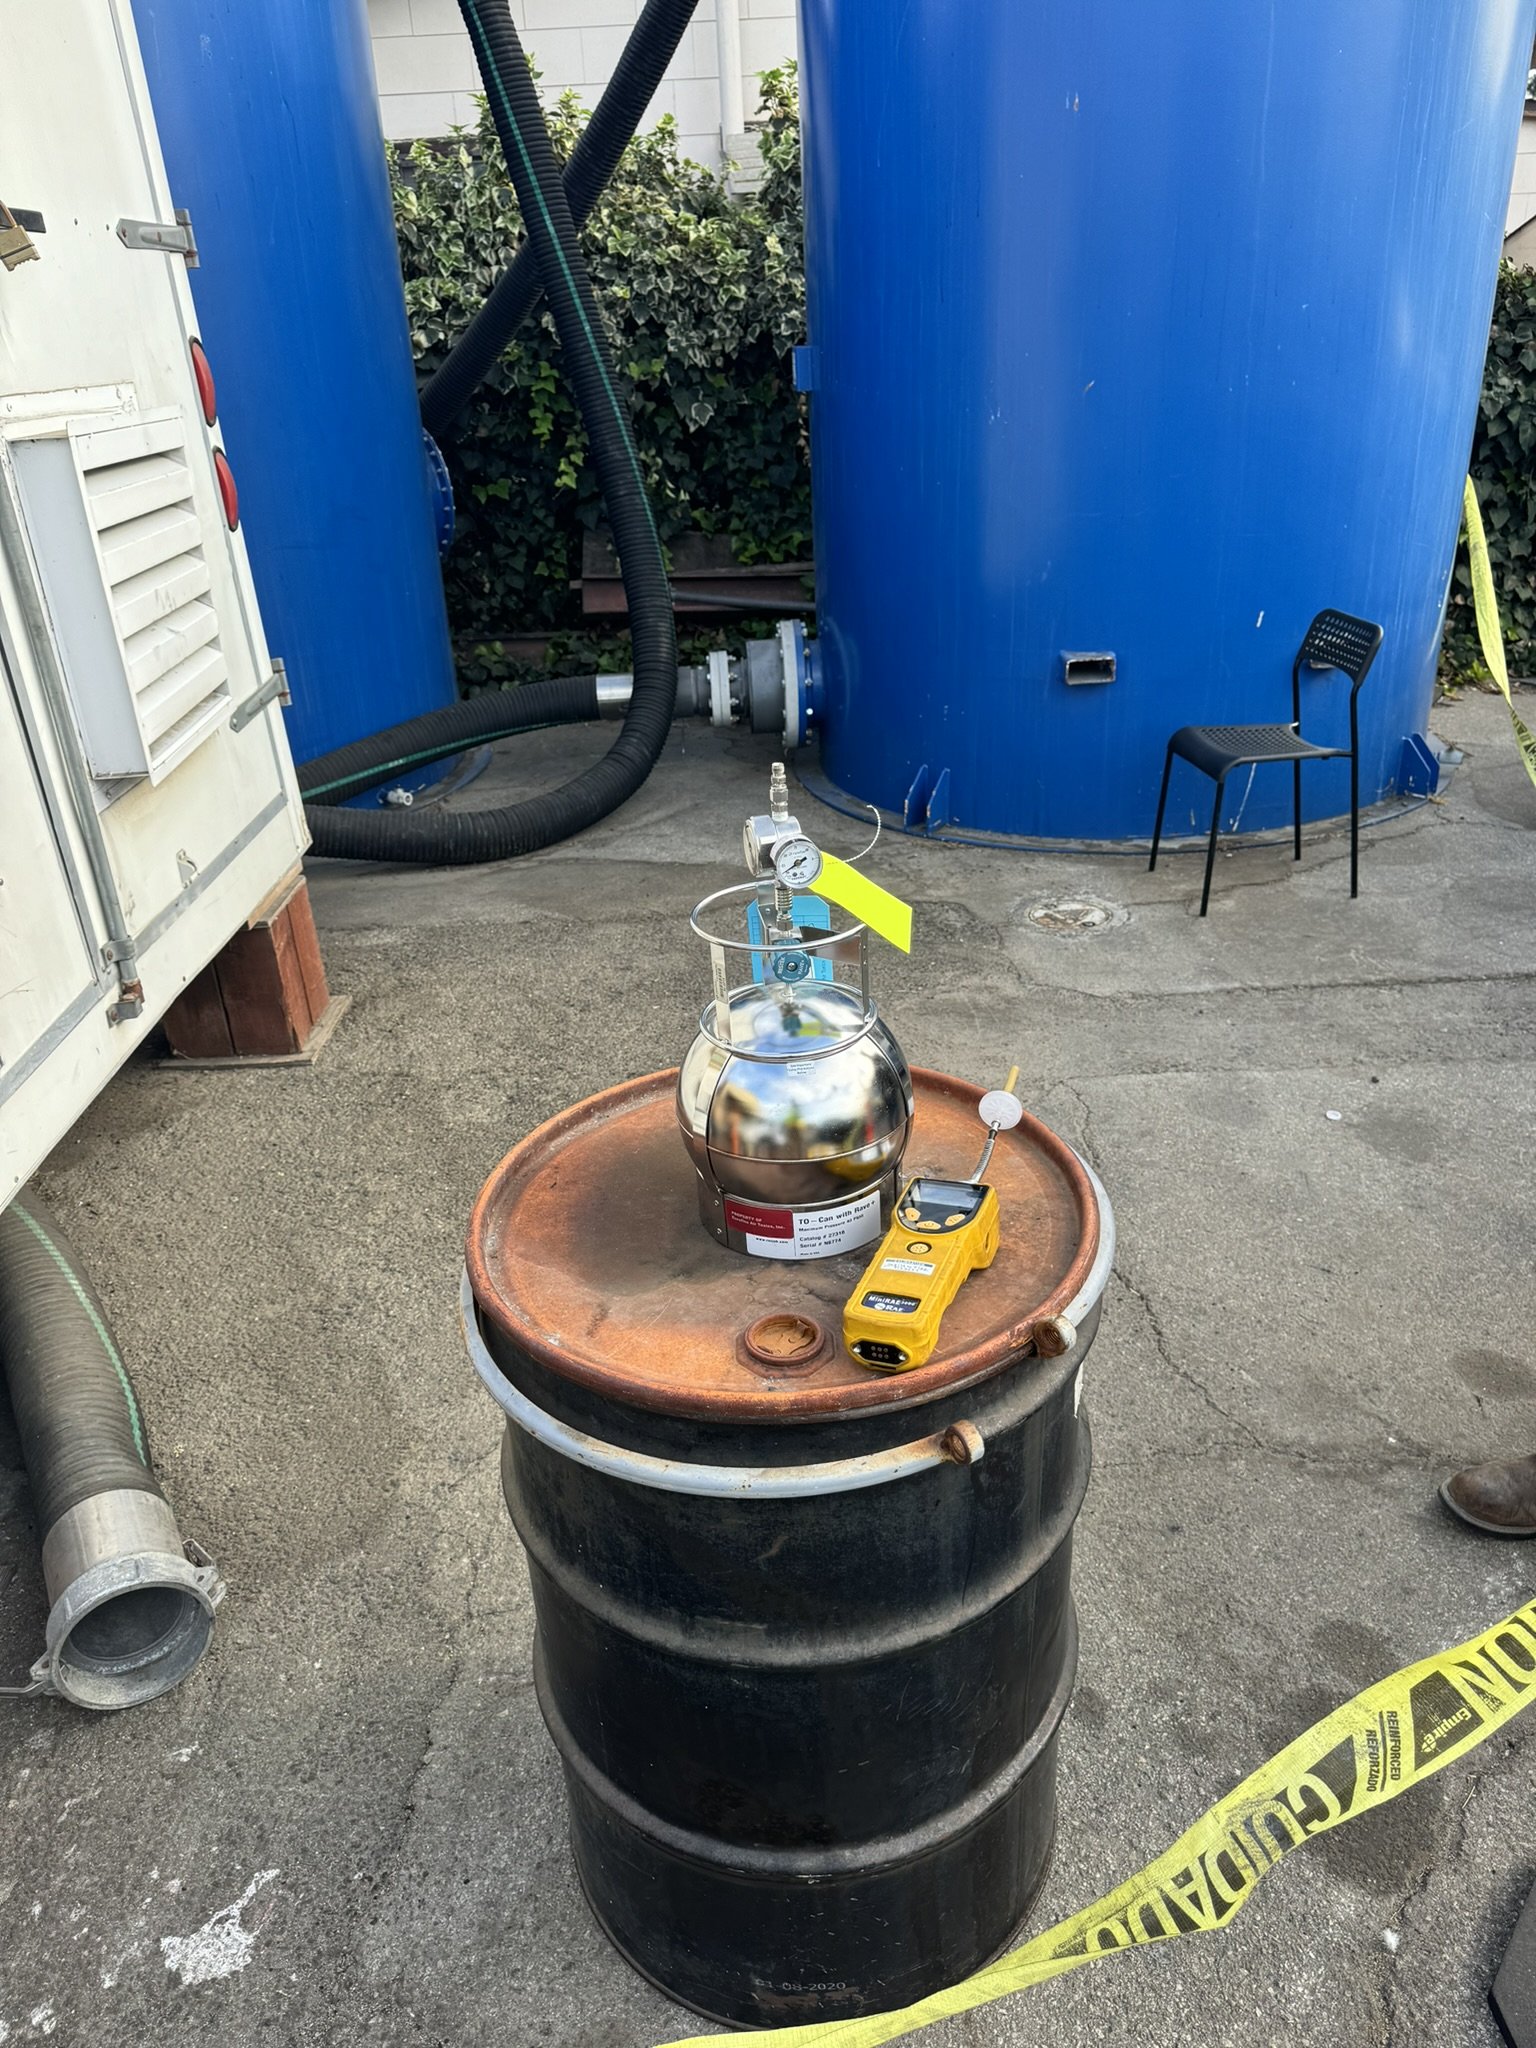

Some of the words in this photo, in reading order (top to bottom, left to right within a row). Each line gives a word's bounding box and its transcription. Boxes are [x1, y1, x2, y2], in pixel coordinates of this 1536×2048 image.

[731, 1211, 754, 1221] PROPERTY
[836, 1210, 852, 1219] with
[854, 1202, 871, 1214] Rave
[1386, 1710, 1402, 1781] REINFORCED
[1424, 1706, 1473, 1744] Empire
[1365, 1729, 1381, 1792] REFORZADO
[1084, 1771, 1342, 1953] CUIDADO
